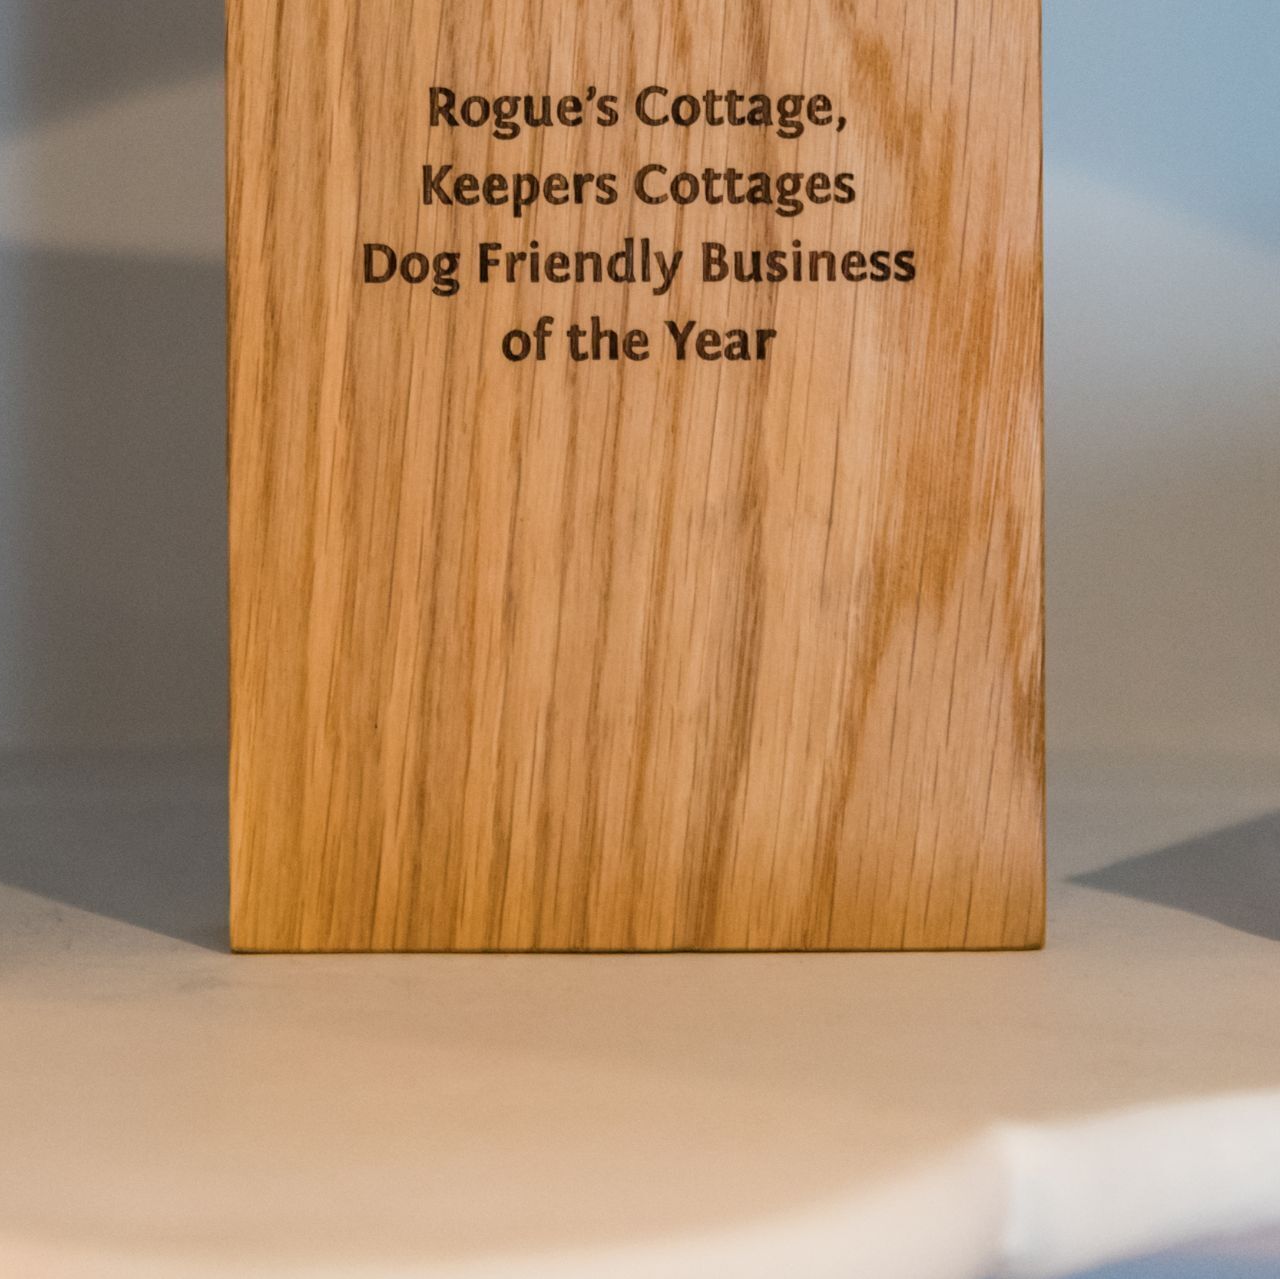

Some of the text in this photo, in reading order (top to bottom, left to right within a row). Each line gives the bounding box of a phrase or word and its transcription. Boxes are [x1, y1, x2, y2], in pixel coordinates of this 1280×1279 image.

[428, 86, 846, 140] Rogue's Cottage,
[422, 164, 856, 217] Keepers Cottages
[363, 238, 916, 296] Dog Friendly Business
[502, 317, 777, 362] of the Year
